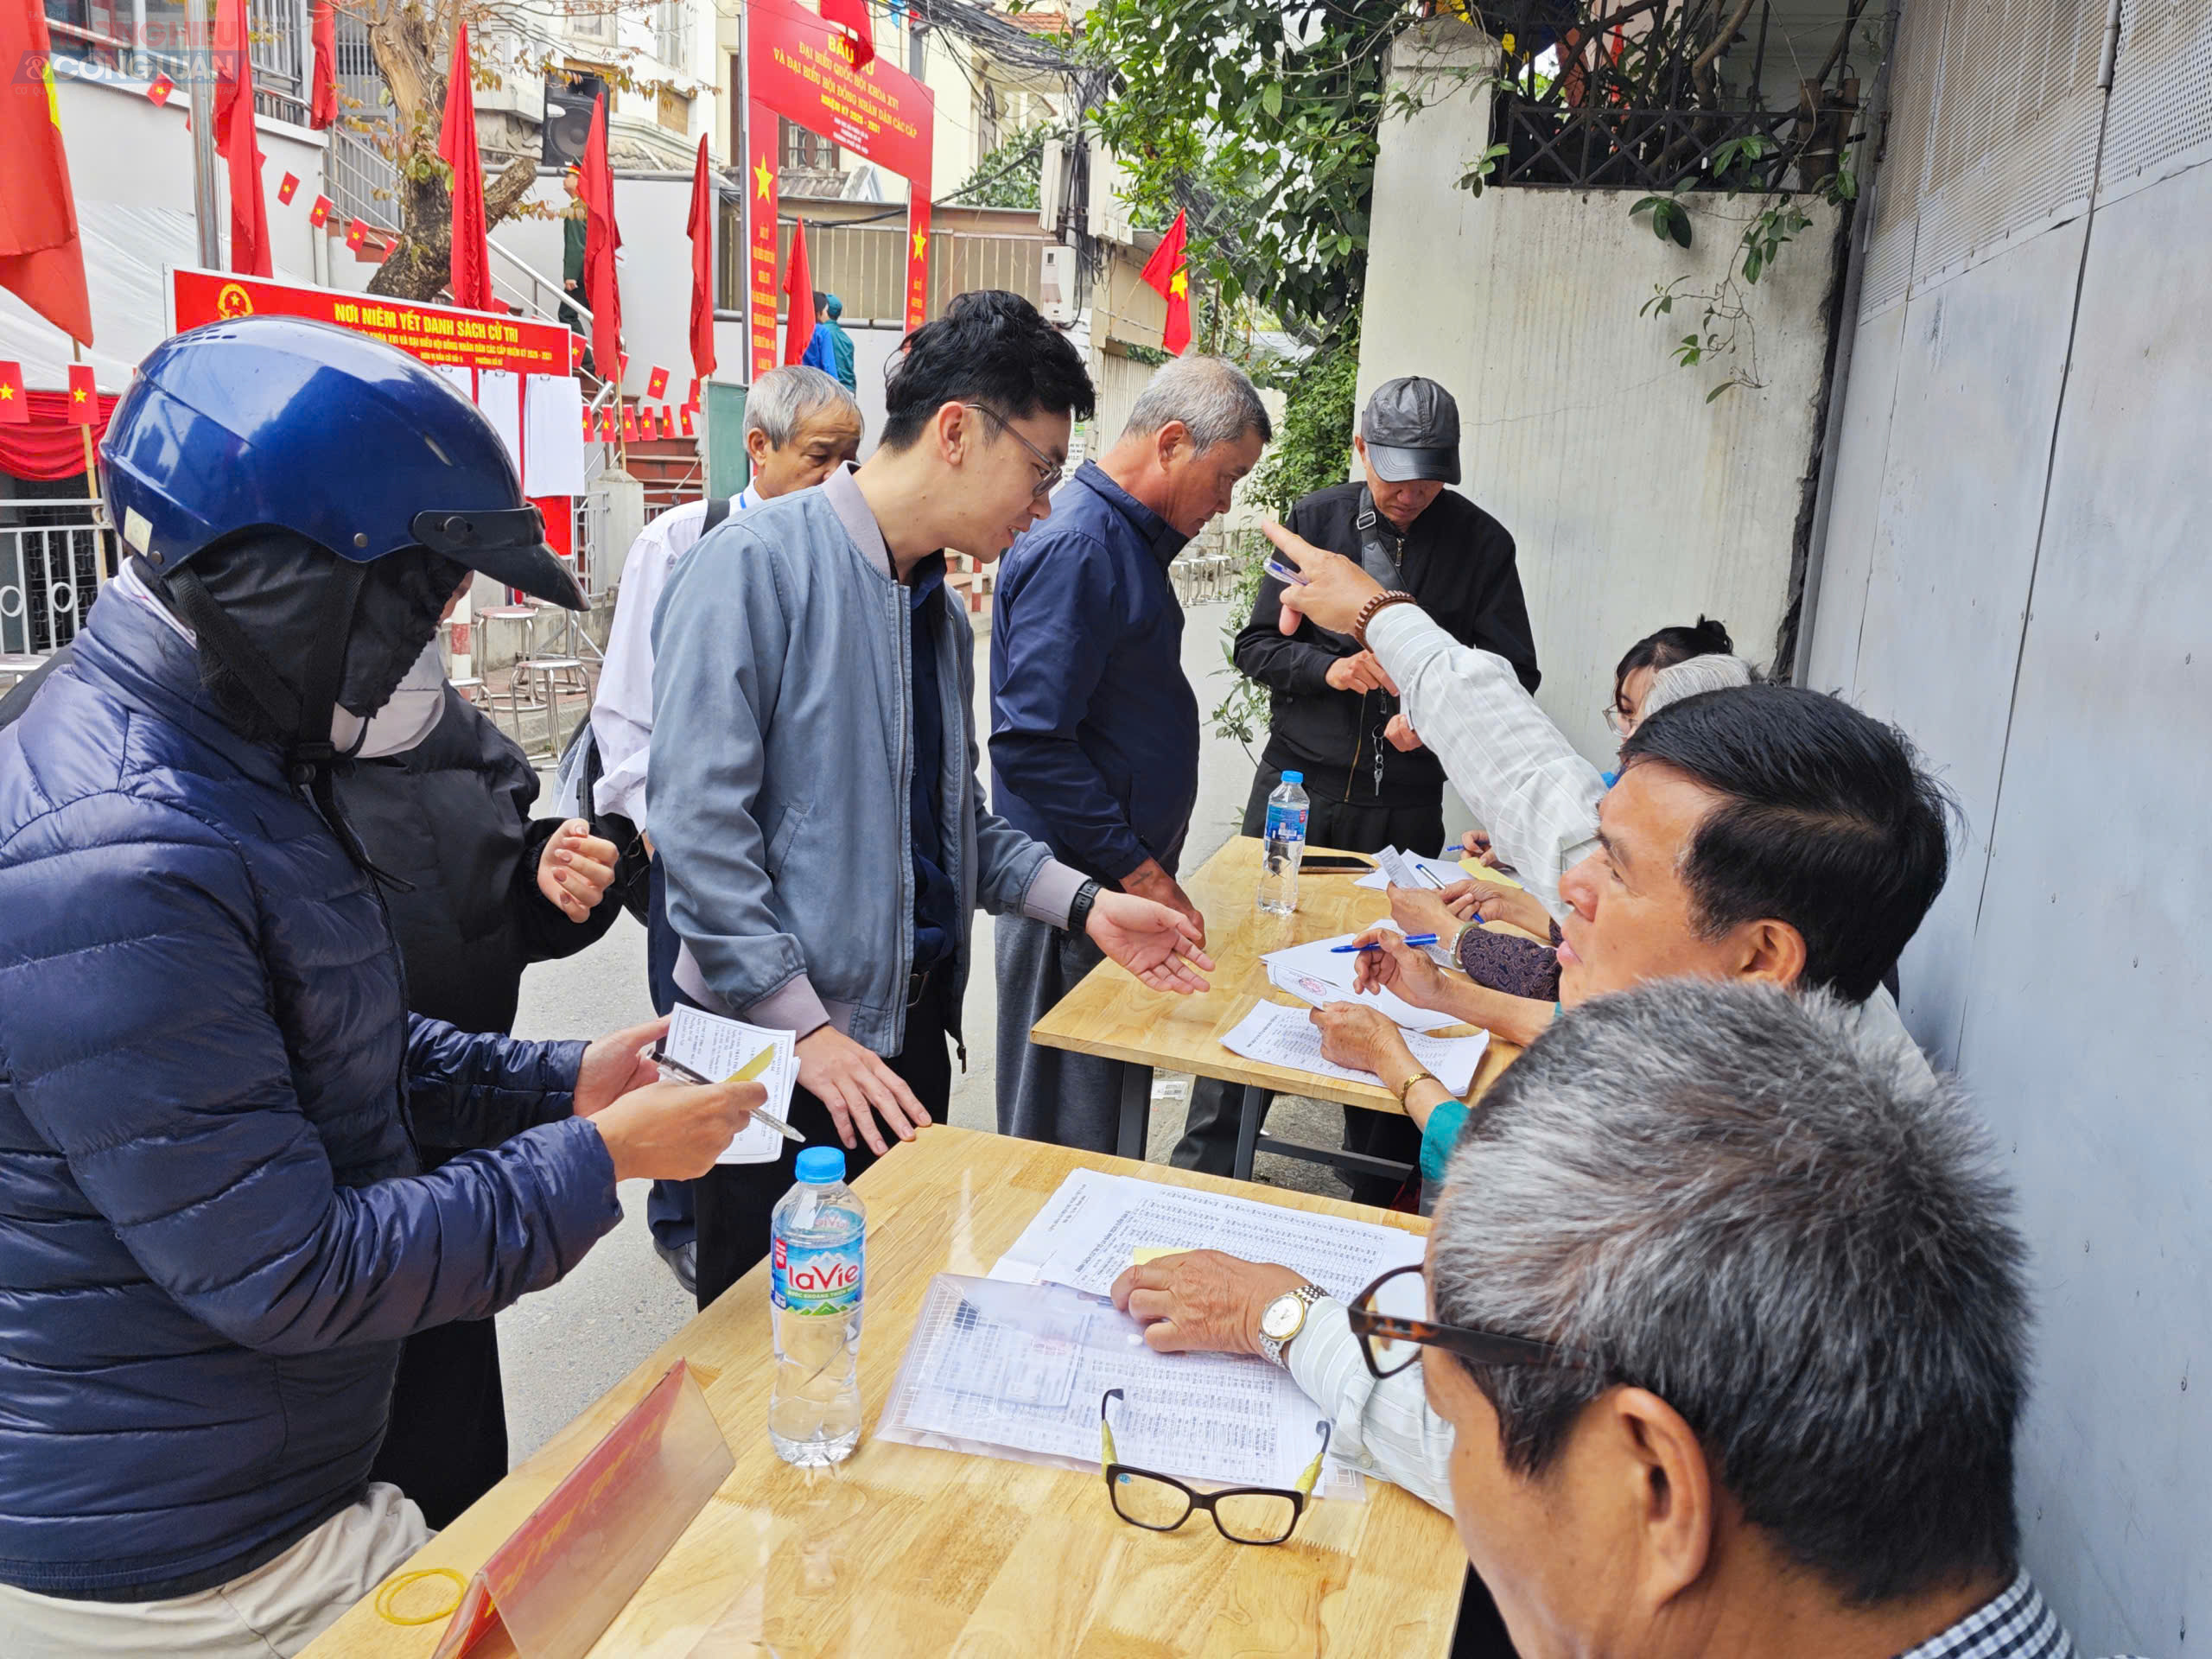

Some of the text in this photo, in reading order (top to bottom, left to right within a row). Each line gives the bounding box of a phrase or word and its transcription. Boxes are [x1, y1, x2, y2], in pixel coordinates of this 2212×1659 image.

[773, 48, 785, 65] VÀ
[334, 302, 518, 343] NƠI NIÊM YẾT DANH SÁCH CỬ TRI
